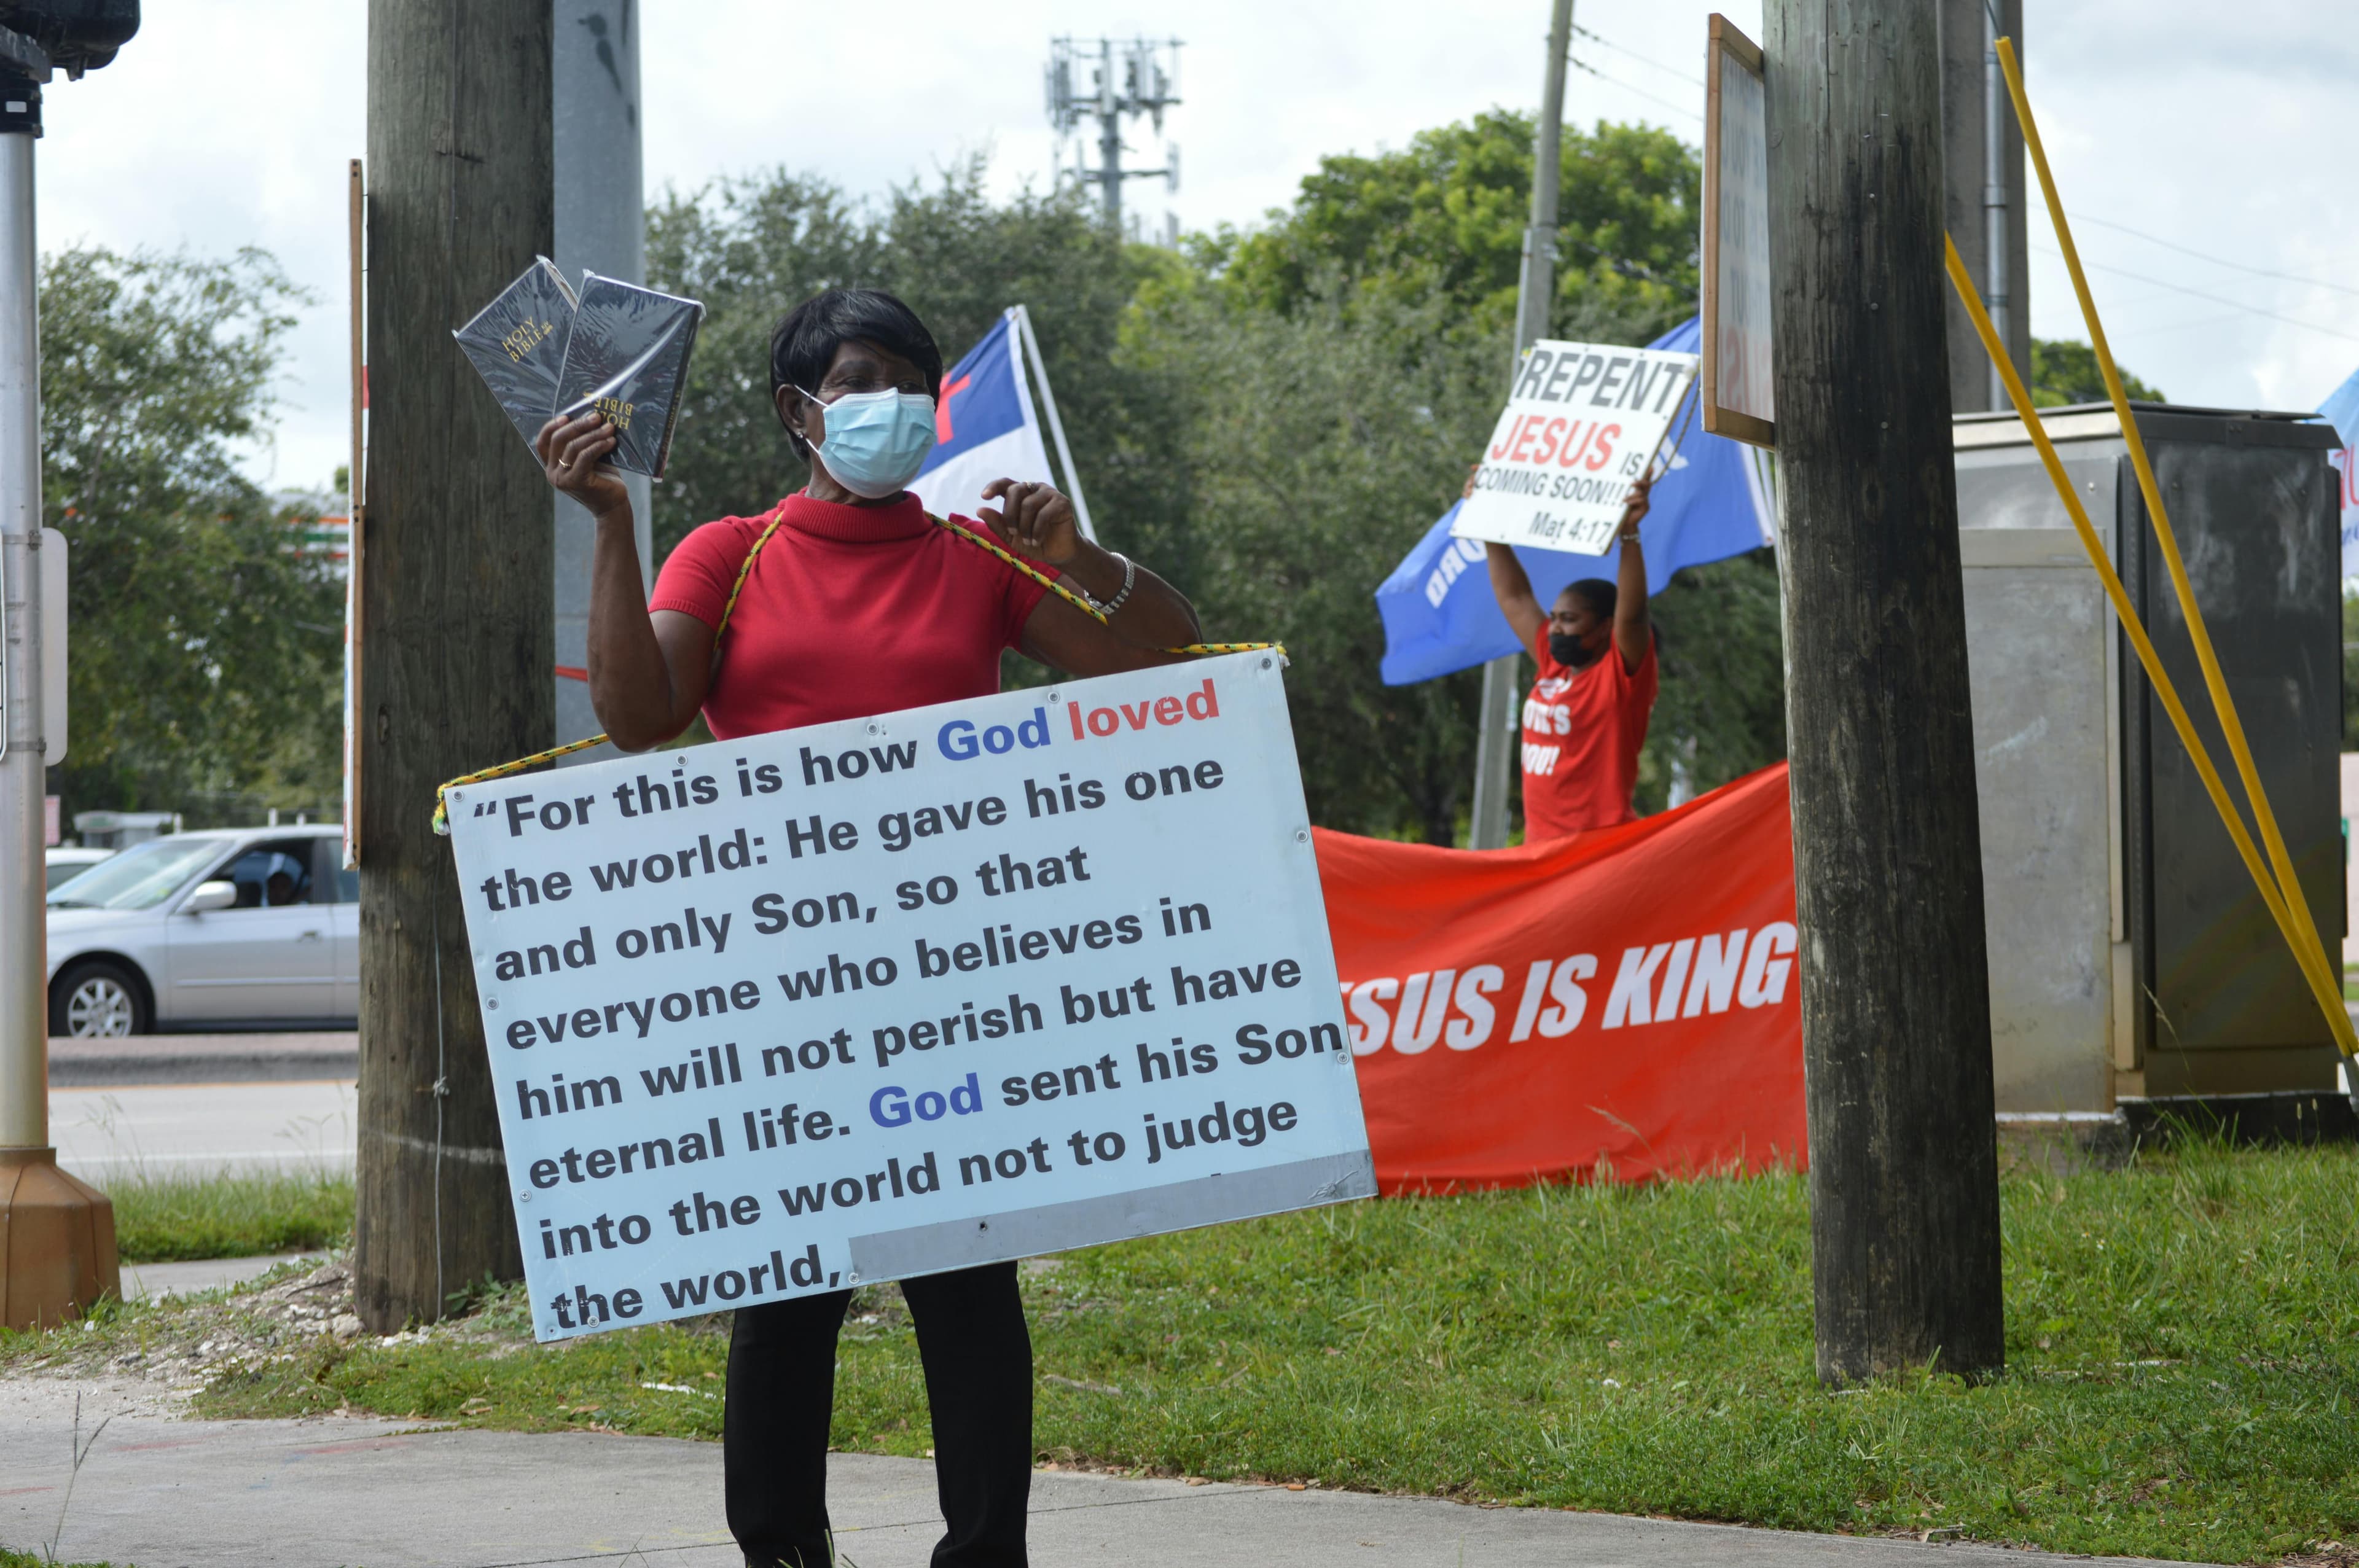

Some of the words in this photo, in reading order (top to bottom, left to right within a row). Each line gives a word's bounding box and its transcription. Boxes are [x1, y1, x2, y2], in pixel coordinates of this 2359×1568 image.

[502, 316, 534, 351] HOLY
[509, 329, 544, 363] BIBLE
[1516, 350, 1686, 413] REPENT
[1474, 466, 1548, 496] COMING
[1492, 415, 1622, 471] JESUS
[1619, 452, 1644, 477] IS
[1528, 511, 1566, 539] Mat
[1568, 518, 1613, 544] 4:17
[612, 769, 718, 817] this
[736, 758, 782, 797] is
[800, 741, 917, 786] how
[938, 707, 1050, 760] God
[1068, 679, 1219, 740] loved
[480, 868, 571, 911] the
[589, 829, 767, 892] world:
[786, 815, 858, 859] He
[878, 797, 1006, 852] gave
[1024, 773, 1105, 818] his
[1125, 760, 1223, 800] one
[496, 926, 596, 981] and
[616, 908, 732, 958] only
[753, 892, 877, 934] Son,
[896, 876, 958, 910] so
[975, 846, 1090, 896] that
[507, 981, 760, 1050] everyone
[778, 954, 898, 1001] who
[915, 915, 1142, 978] believes
[1159, 897, 1211, 937] in
[516, 1074, 622, 1120] him
[640, 1043, 742, 1097] will
[762, 1028, 855, 1077] not
[872, 994, 1043, 1067] perish
[1060, 977, 1155, 1024] but
[1171, 959, 1301, 1005] have
[1340, 964, 1504, 1056] SUS
[1508, 954, 1598, 1043] IS
[1601, 921, 1798, 1030] KING
[530, 1117, 724, 1188] eternal
[743, 1104, 850, 1152] life.
[869, 1072, 983, 1128] God
[1001, 1053, 1121, 1106] sent
[1136, 1037, 1218, 1083] his
[1236, 1023, 1342, 1065] Son
[539, 1214, 651, 1259] into
[668, 1192, 761, 1236] the
[778, 1152, 940, 1216] world
[958, 1137, 1052, 1185] not
[1067, 1130, 1125, 1166] to
[1143, 1101, 1297, 1164] judge
[550, 1285, 643, 1328] the
[660, 1244, 840, 1309] world,
